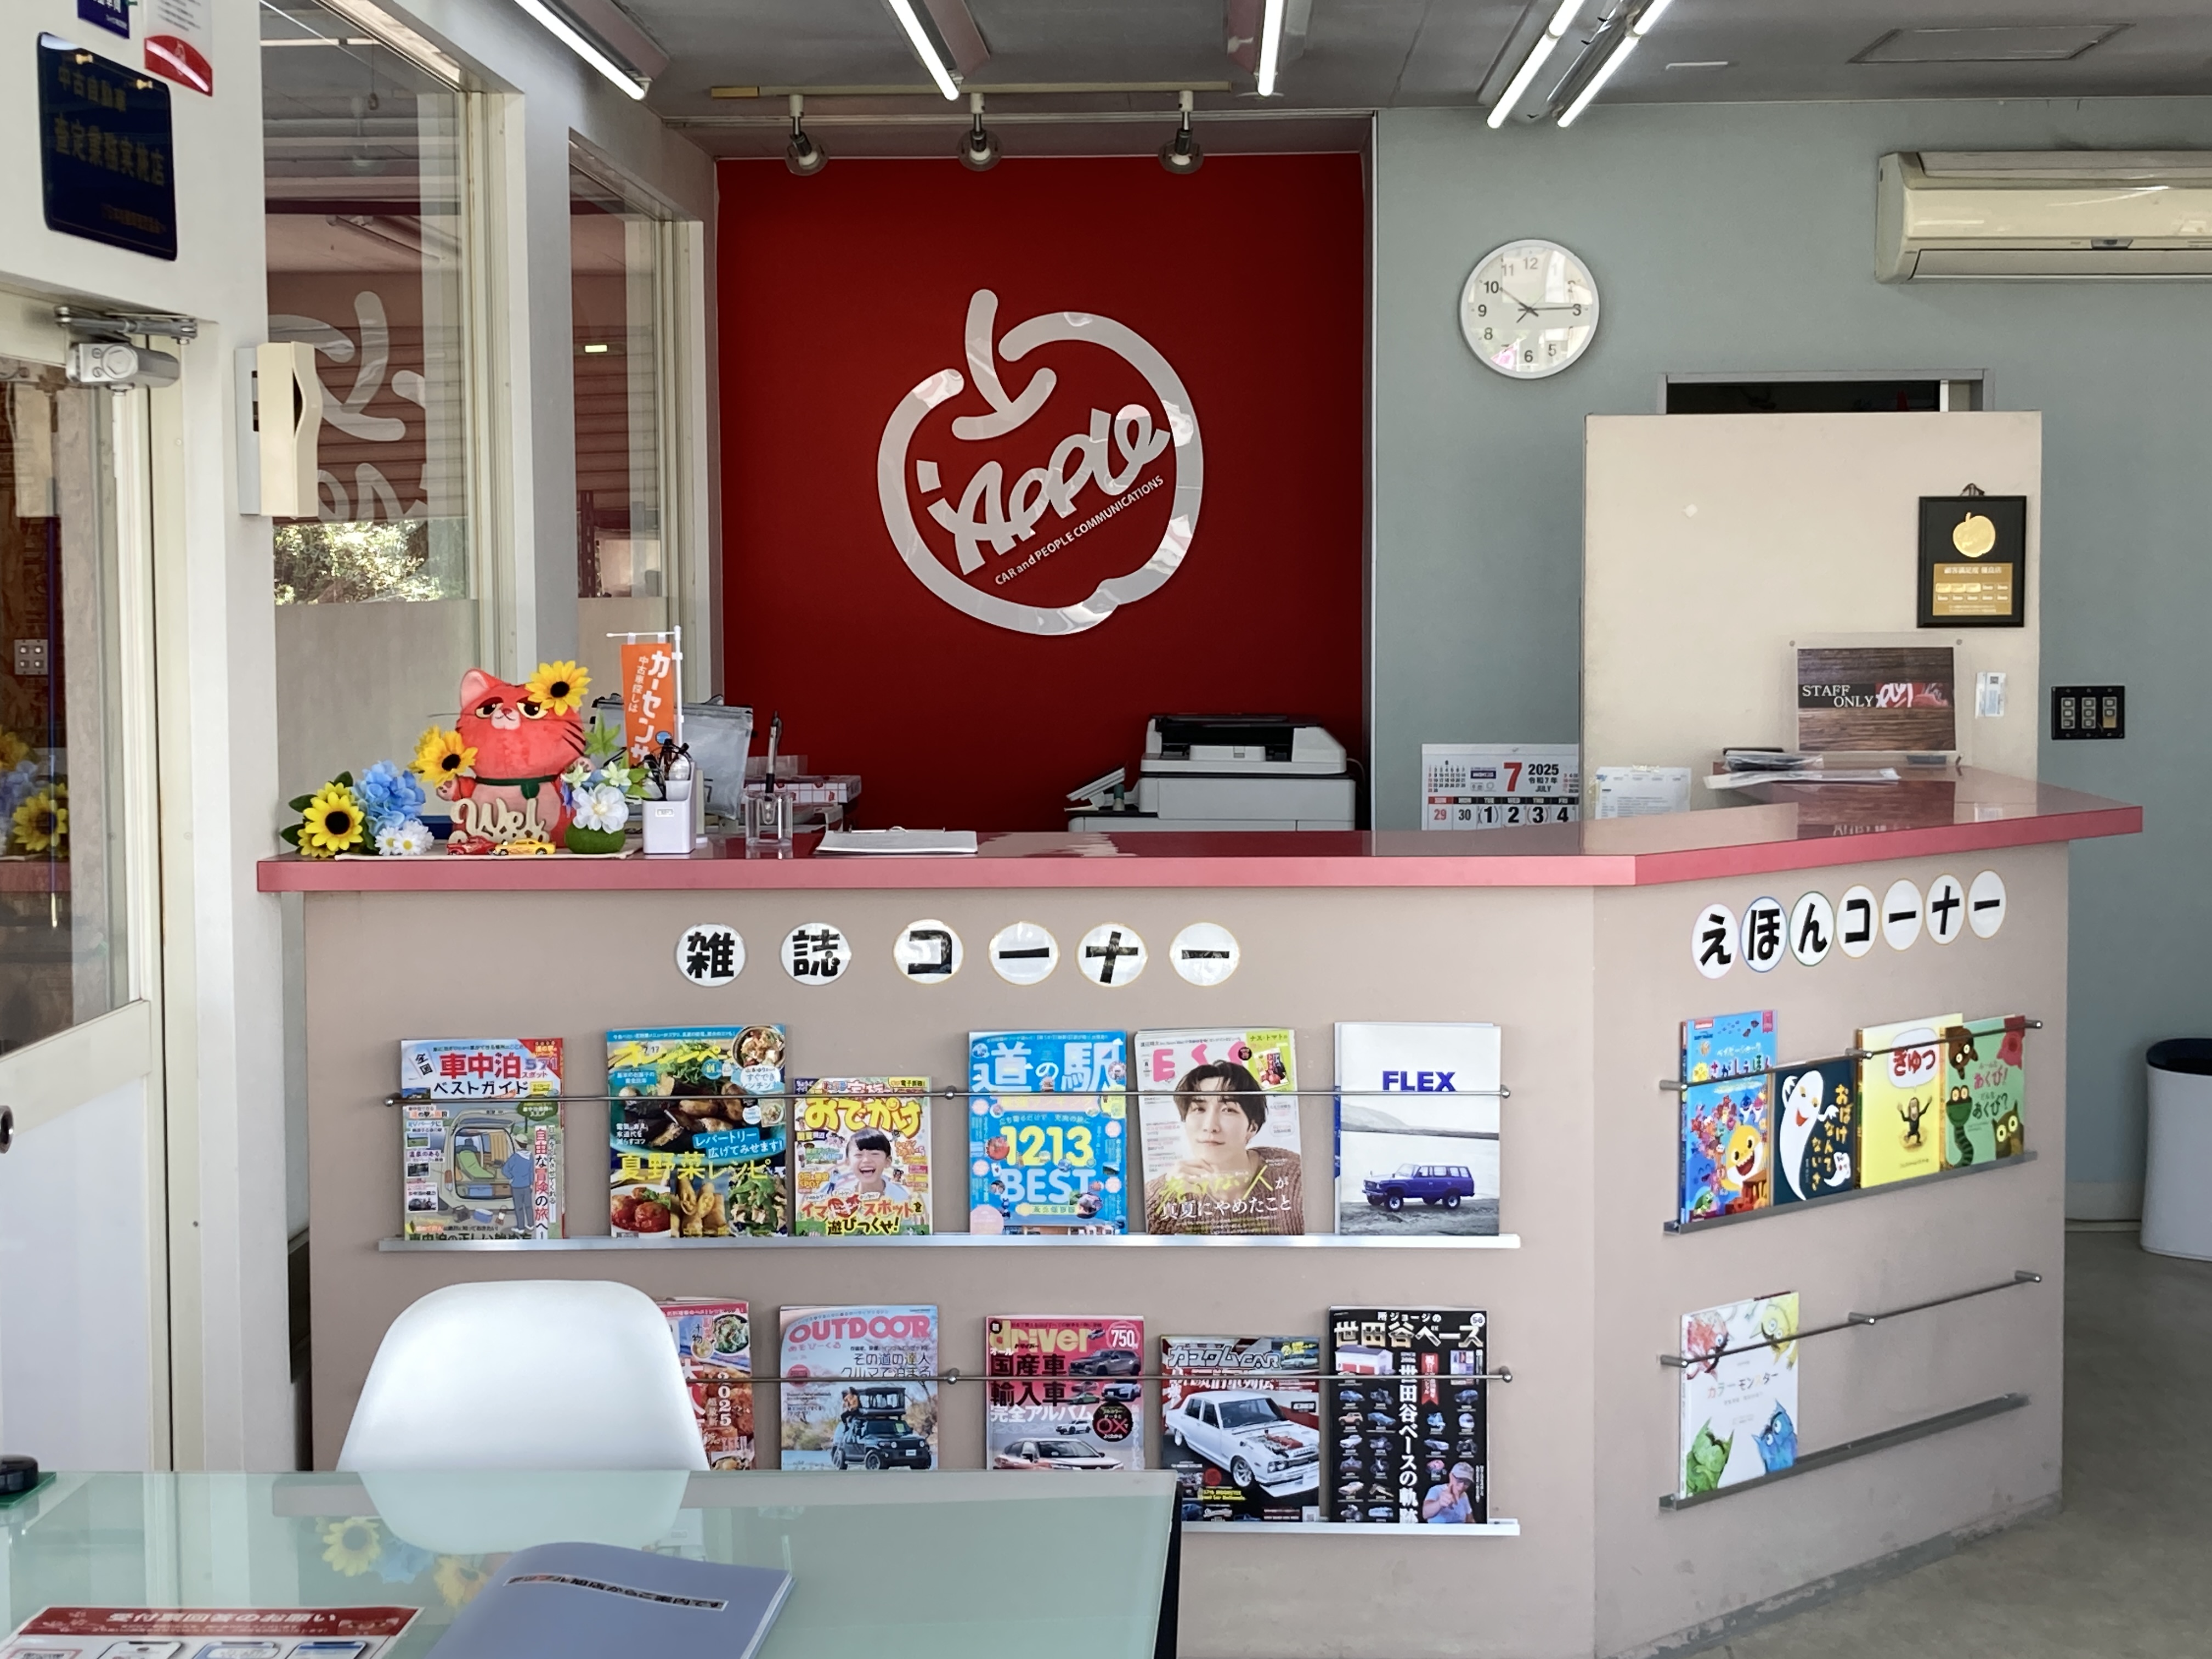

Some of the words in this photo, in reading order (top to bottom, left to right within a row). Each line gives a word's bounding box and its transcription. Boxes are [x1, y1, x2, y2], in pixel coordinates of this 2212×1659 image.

[1502, 264, 1514, 276] 11
[1523, 257, 1538, 269] 12
[1484, 281, 1499, 293] 10
[1478, 304, 1487, 317] 9
[1572, 303, 1581, 315] 3
[1484, 328, 1493, 340] 8
[1524, 350, 1533, 362] 6
[1549, 344, 1556, 356] 5
[916, 404, 1171, 576] Apple
[995, 567, 1017, 585] CAR
[1017, 554, 1036, 574] and
[1034, 531, 1075, 561] PEOPLE
[1073, 475, 1164, 538] COMMUNICATIONS
[1802, 685, 1850, 697] STAFF
[1833, 696, 1874, 708] ONLY
[1503, 762, 1522, 792] 7
[1528, 764, 1559, 776] 2025
[1434, 809, 1446, 821] 29
[1458, 809, 1471, 821] 30
[1508, 807, 1520, 823] 2
[1556, 807, 1569, 823] 4
[1700, 885, 2000, 966] えほんコーナー
[415, 1053, 433, 1076] 全国
[439, 1052, 521, 1079] 車中泊
[972, 1041, 1124, 1092] 道の駅
[434, 1081, 528, 1094] ベストガイド
[1382, 1071, 1457, 1092] FLEX
[805, 1097, 922, 1138] おでかけ
[1835, 1084, 1853, 1144] おばけ
[695, 1131, 757, 1147] レパートリー
[1000, 1126, 1094, 1167] 1213
[617, 1151, 771, 1181] 夏野菜レシピ
[1000, 1169, 1096, 1203] BEST
[1162, 1194, 1292, 1220] 真夏にやめたこと
[1378, 1311, 1442, 1322] 所ジョージの
[788, 1316, 930, 1343] OUTDOOR
[989, 1320, 1089, 1353] driver
[1334, 1321, 1483, 1348] 世田谷ベース
[991, 1353, 1066, 1376] 国産車
[990, 1380, 1066, 1407] 輸入車
[1708, 1373, 1779, 1398] カラーモンスター
[990, 1405, 1093, 1423] 完全アルバム
